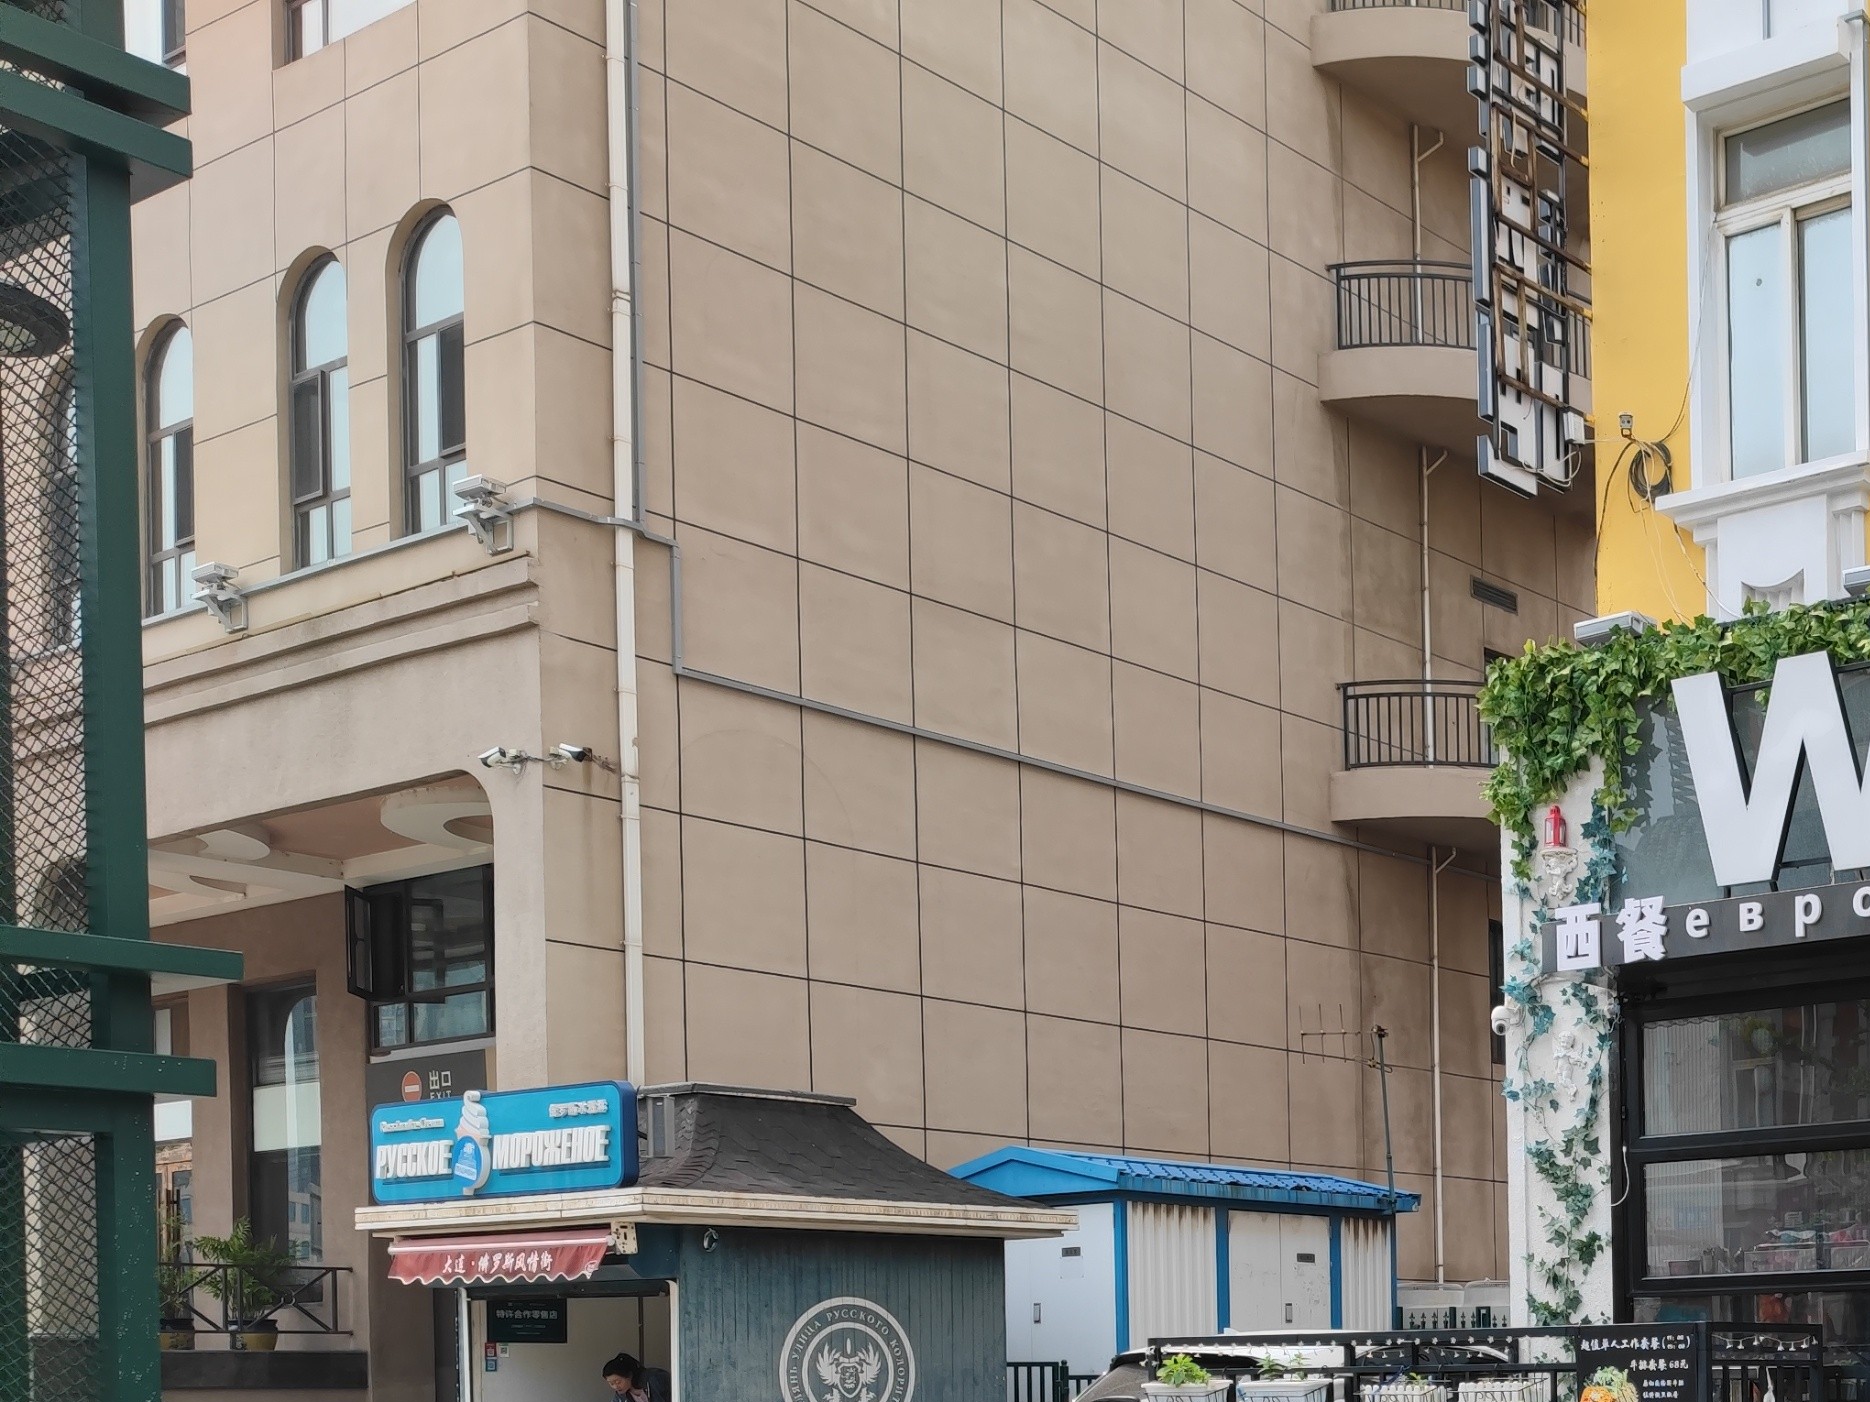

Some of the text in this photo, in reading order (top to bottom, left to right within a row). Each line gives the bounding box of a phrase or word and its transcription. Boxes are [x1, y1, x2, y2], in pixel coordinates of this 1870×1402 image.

[1553, 895, 1669, 974] 西餐
[429, 1070, 452, 1090] 出口
[376, 1139, 454, 1180] РУССКОЕ
[492, 1125, 611, 1170] МОРОЖЕНОЕ
[826, 1308, 890, 1336] РУССКОГО
